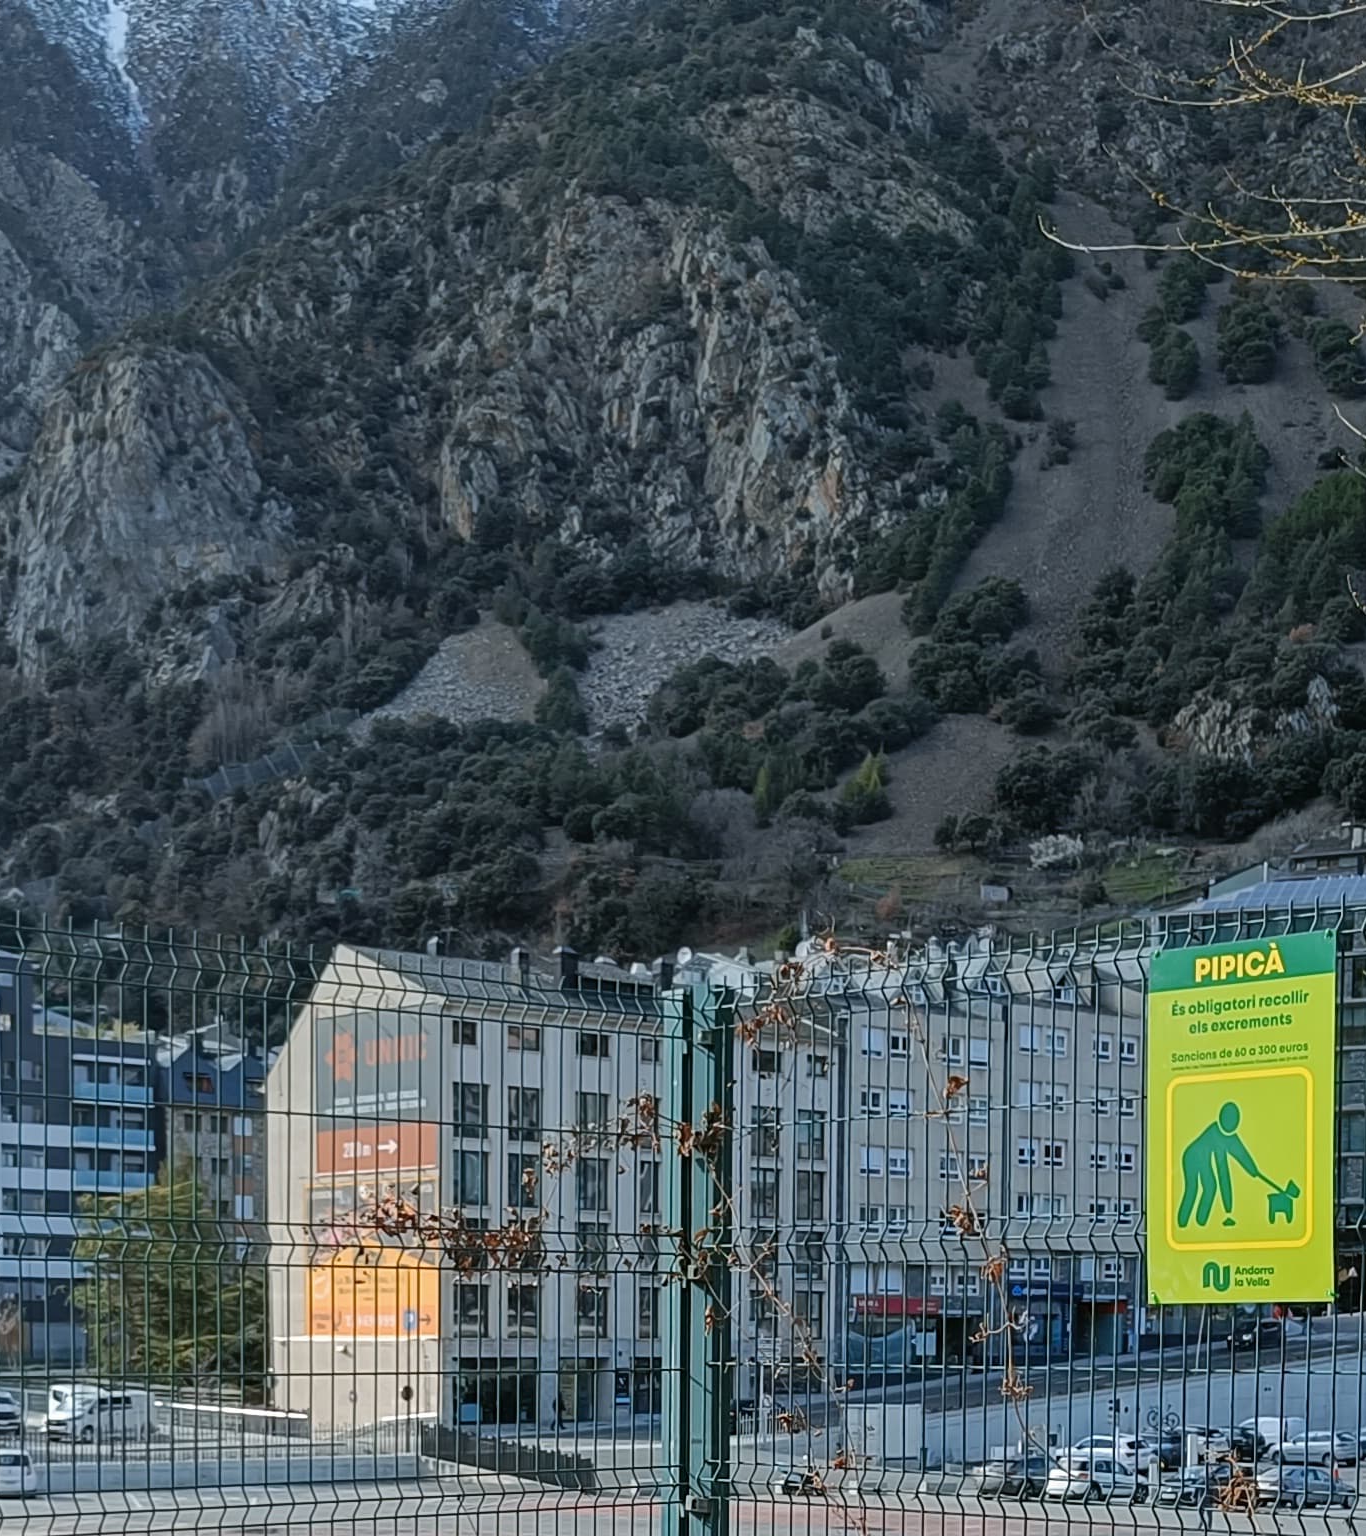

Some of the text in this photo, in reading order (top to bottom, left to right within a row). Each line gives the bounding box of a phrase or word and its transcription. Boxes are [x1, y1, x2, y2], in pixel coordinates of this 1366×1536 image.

[1194, 942, 1285, 983] PIPICÀ
[1171, 989, 1310, 1017] És obligatori recollir
[1189, 1013, 1292, 1034] els excrements
[1171, 1049, 1217, 1063] Sancions
[1219, 1047, 1233, 1059] de
[1234, 1046, 1247, 1057] 60
[1248, 1047, 1256, 1056] a
[1258, 1044, 1276, 1055] 300
[1279, 1042, 1308, 1053] euros
[1234, 1265, 1275, 1275] Andorra
[1234, 1277, 1270, 1287] la Vella
